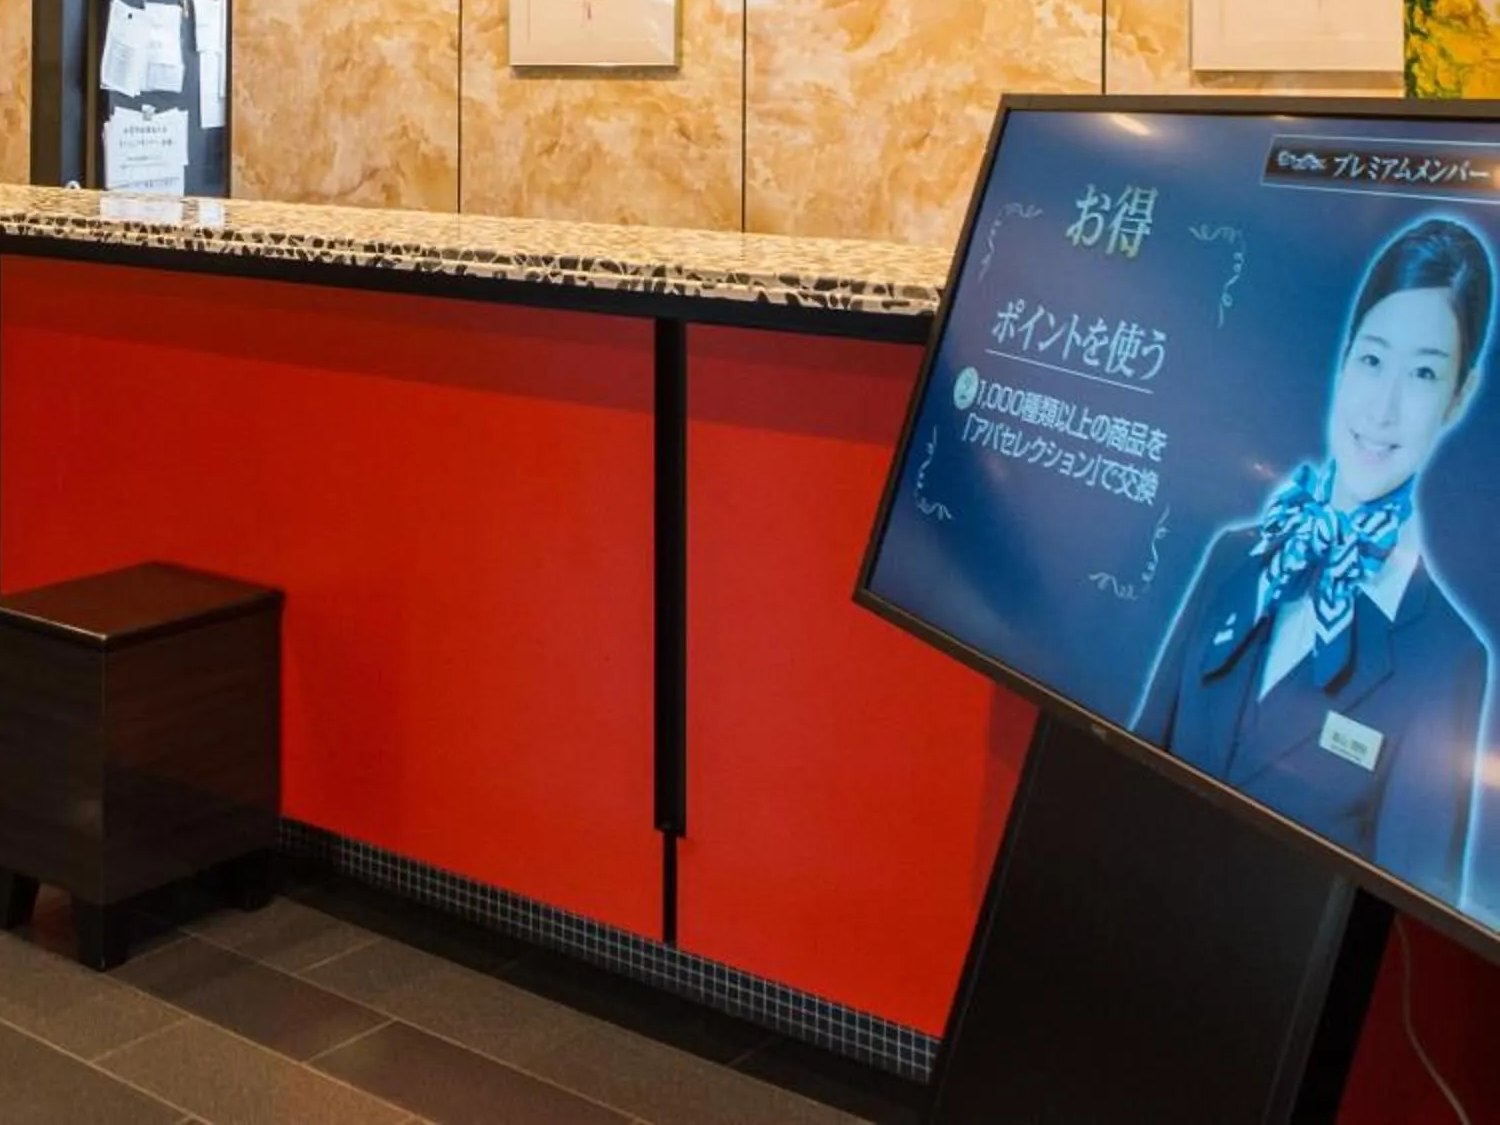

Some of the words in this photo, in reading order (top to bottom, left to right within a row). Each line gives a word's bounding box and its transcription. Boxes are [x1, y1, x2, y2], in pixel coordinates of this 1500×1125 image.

[1333, 153, 1490, 183] プレミアムメンバー
[1066, 183, 1158, 258] お得
[991, 298, 1166, 380] ポイントを使う
[963, 413, 1159, 505] 「アパセレクション」で交換
[977, 379, 1168, 462] 1,000種類以上の商品を
